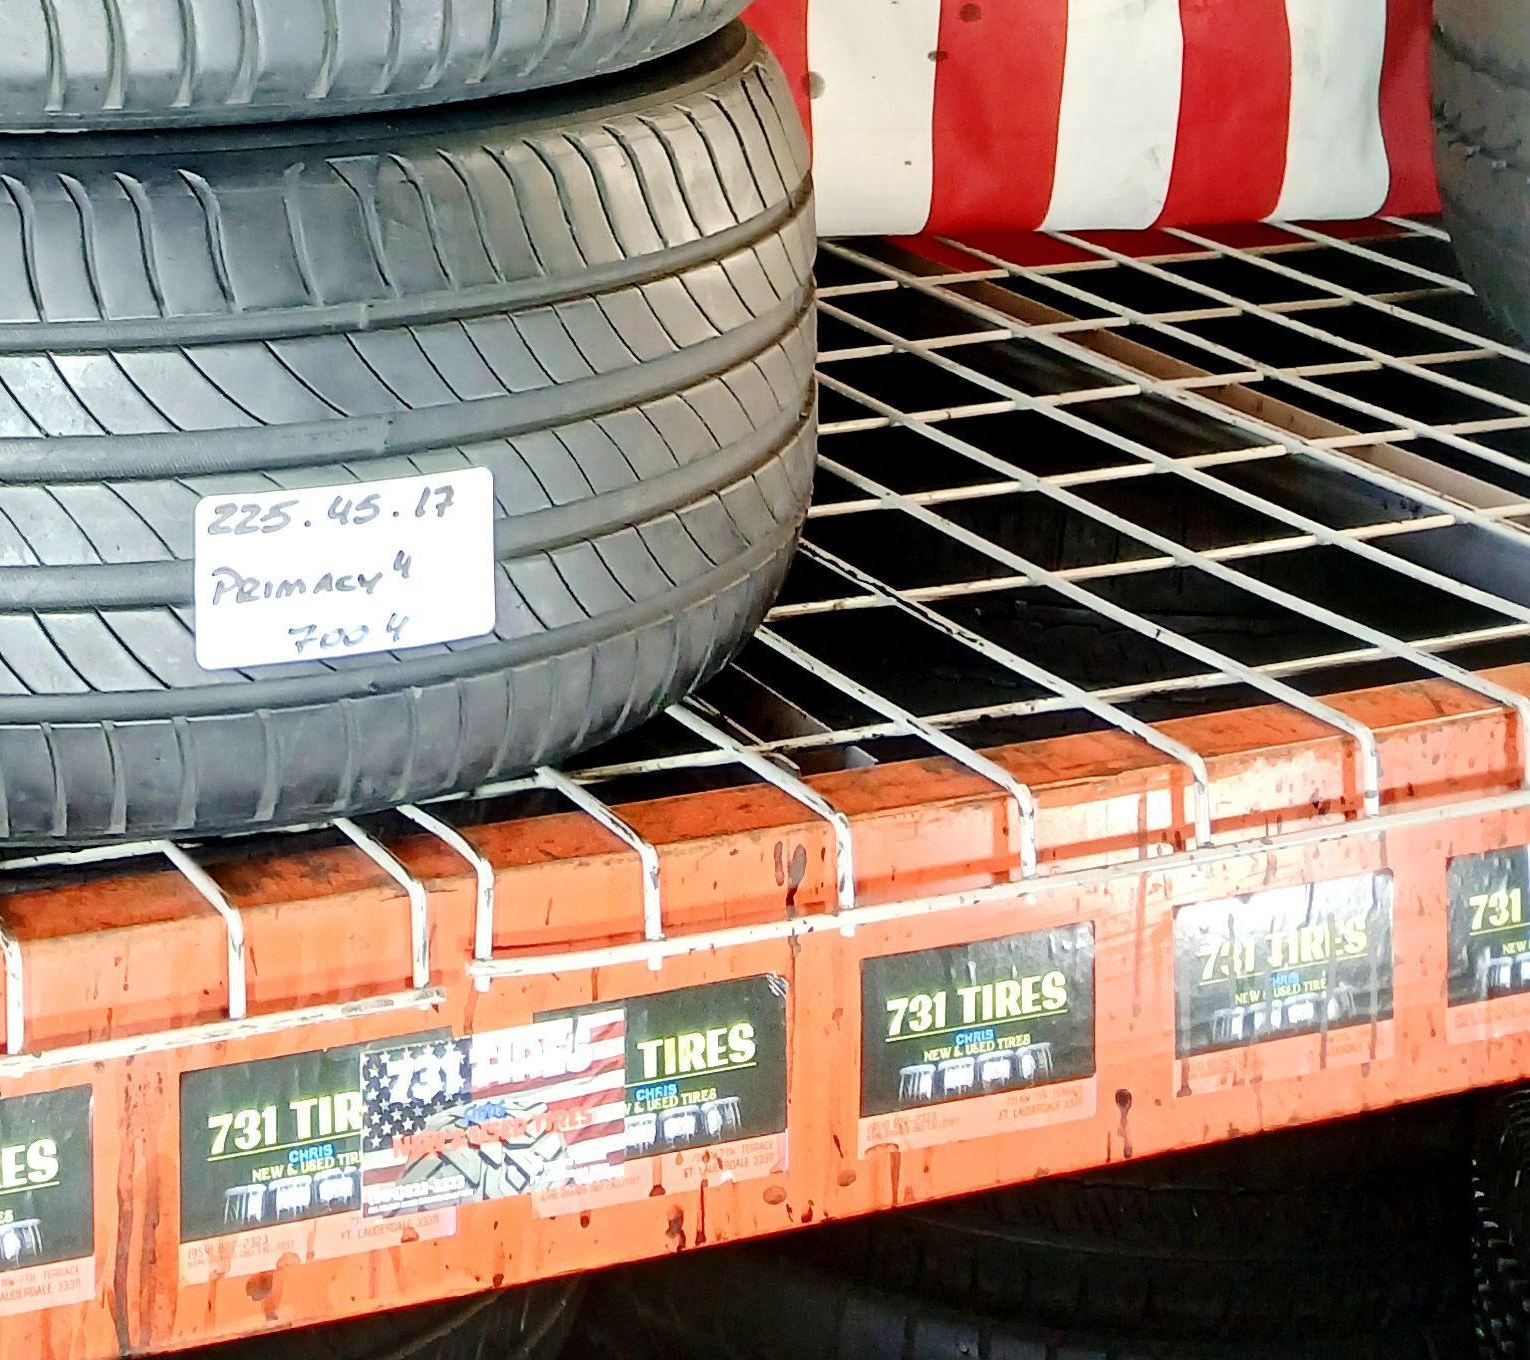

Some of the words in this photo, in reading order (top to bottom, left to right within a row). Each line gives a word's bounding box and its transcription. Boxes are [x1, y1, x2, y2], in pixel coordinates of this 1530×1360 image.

[1470, 888, 1521, 930] 731
[1502, 940, 1527, 955] NEW
[887, 991, 947, 1036] 731
[957, 970, 1068, 1024] TIRES
[1235, 990, 1260, 1005] NEW
[1273, 983, 1301, 999] USED
[1302, 978, 1327, 993] TIRE
[636, 1022, 756, 1079] TIRES
[924, 1047, 952, 1062] NEW
[965, 1040, 995, 1055] USED
[996, 1033, 1031, 1050] TIRES
[955, 1028, 995, 1046] CHRIS
[387, 1047, 466, 1104] 731
[636, 1083, 678, 1101] CHRIS
[646, 1094, 679, 1111] USED
[680, 1087, 717, 1105] TIRES
[207, 1105, 278, 1155] 731
[289, 1091, 362, 1140] TIR
[252, 1167, 286, 1183] NEW
[300, 1156, 334, 1174] USED
[336, 1152, 362, 1168] TIR
[289, 1143, 333, 1164] CHRIS
